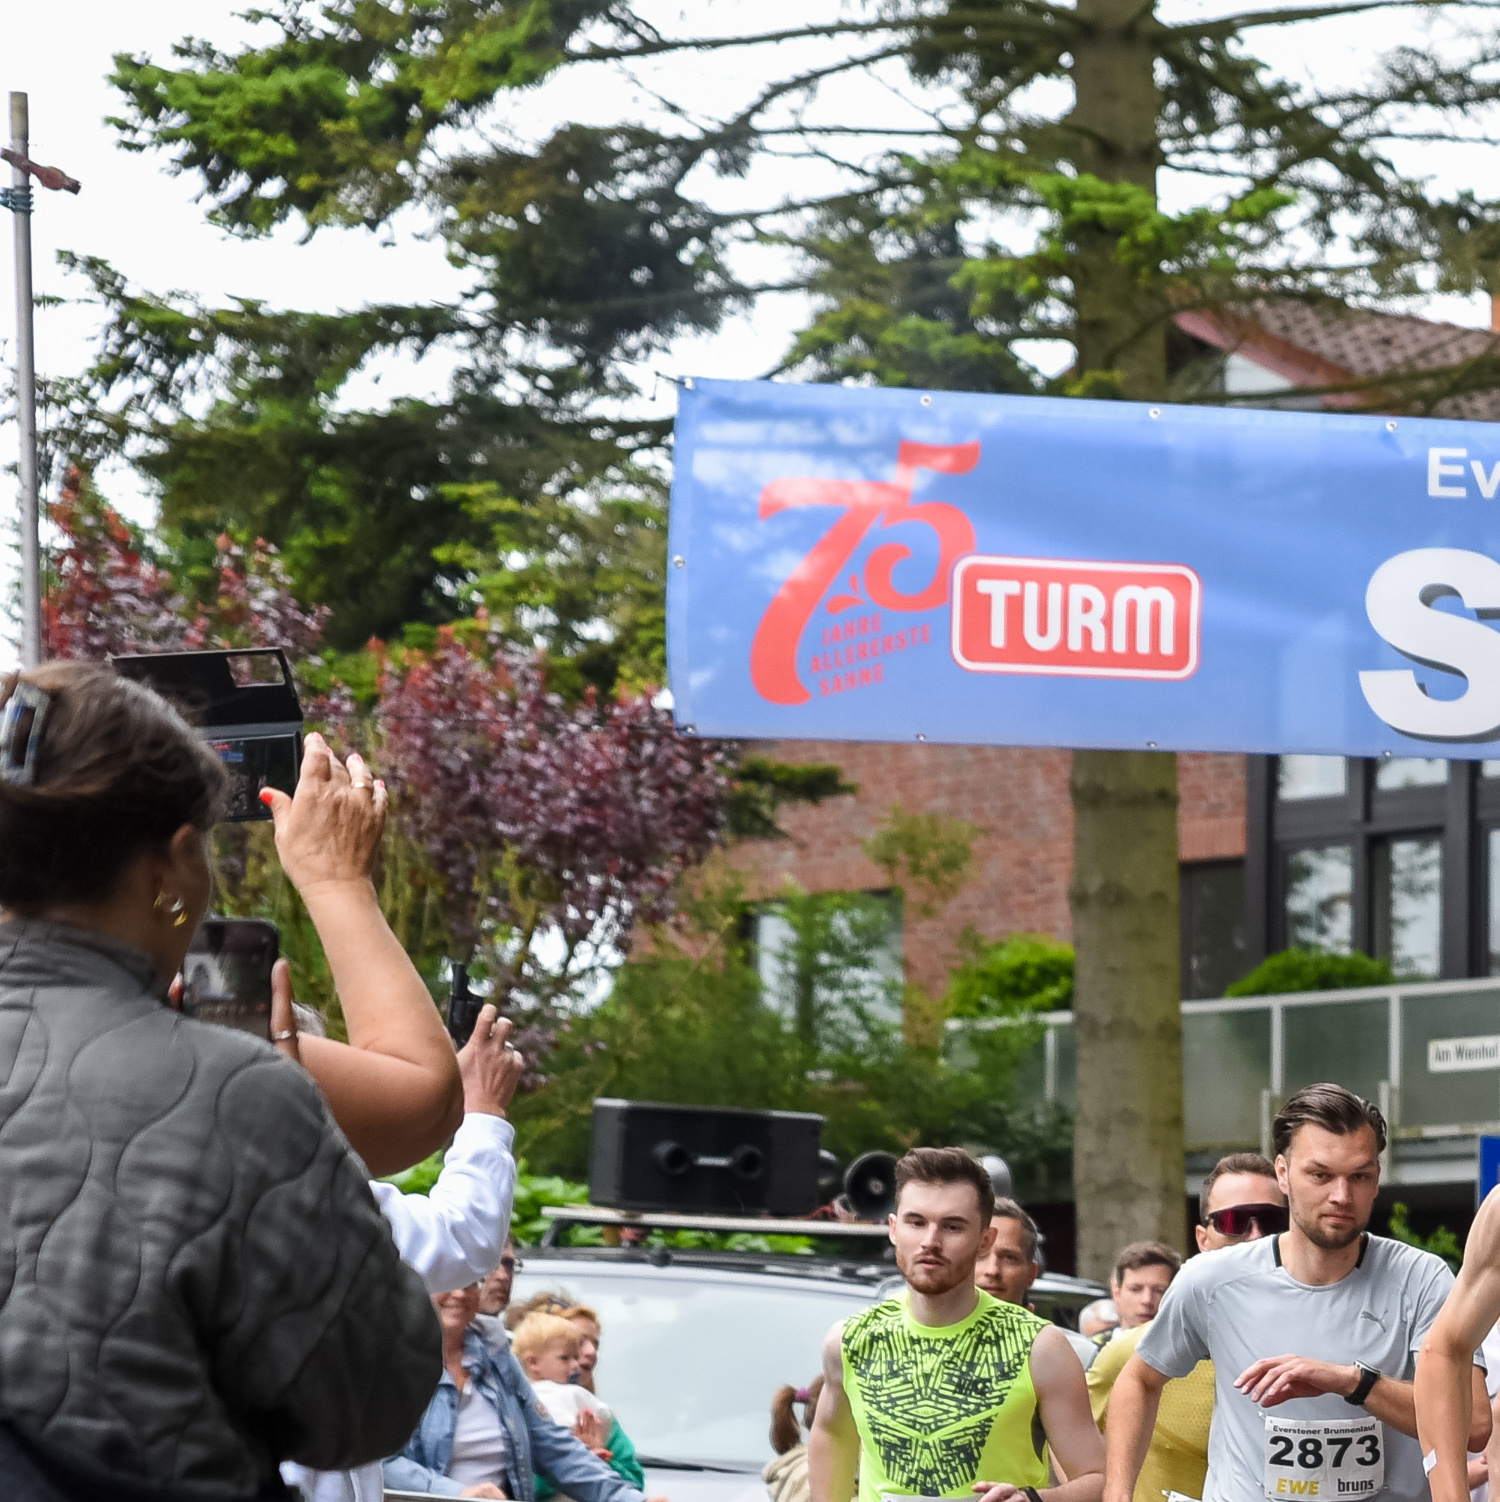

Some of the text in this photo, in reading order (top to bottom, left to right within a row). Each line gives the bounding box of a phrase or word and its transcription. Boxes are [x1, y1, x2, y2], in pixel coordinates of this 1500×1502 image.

[750, 440, 981, 705] 75
[976, 579, 1176, 656] TURM
[1435, 1046, 1451, 1063] Am
[1272, 1423, 1376, 1435] Everstener Brunnenlauf
[1268, 1434, 1381, 1469] 2873
[1276, 1477, 1375, 1496] EWE bruns
